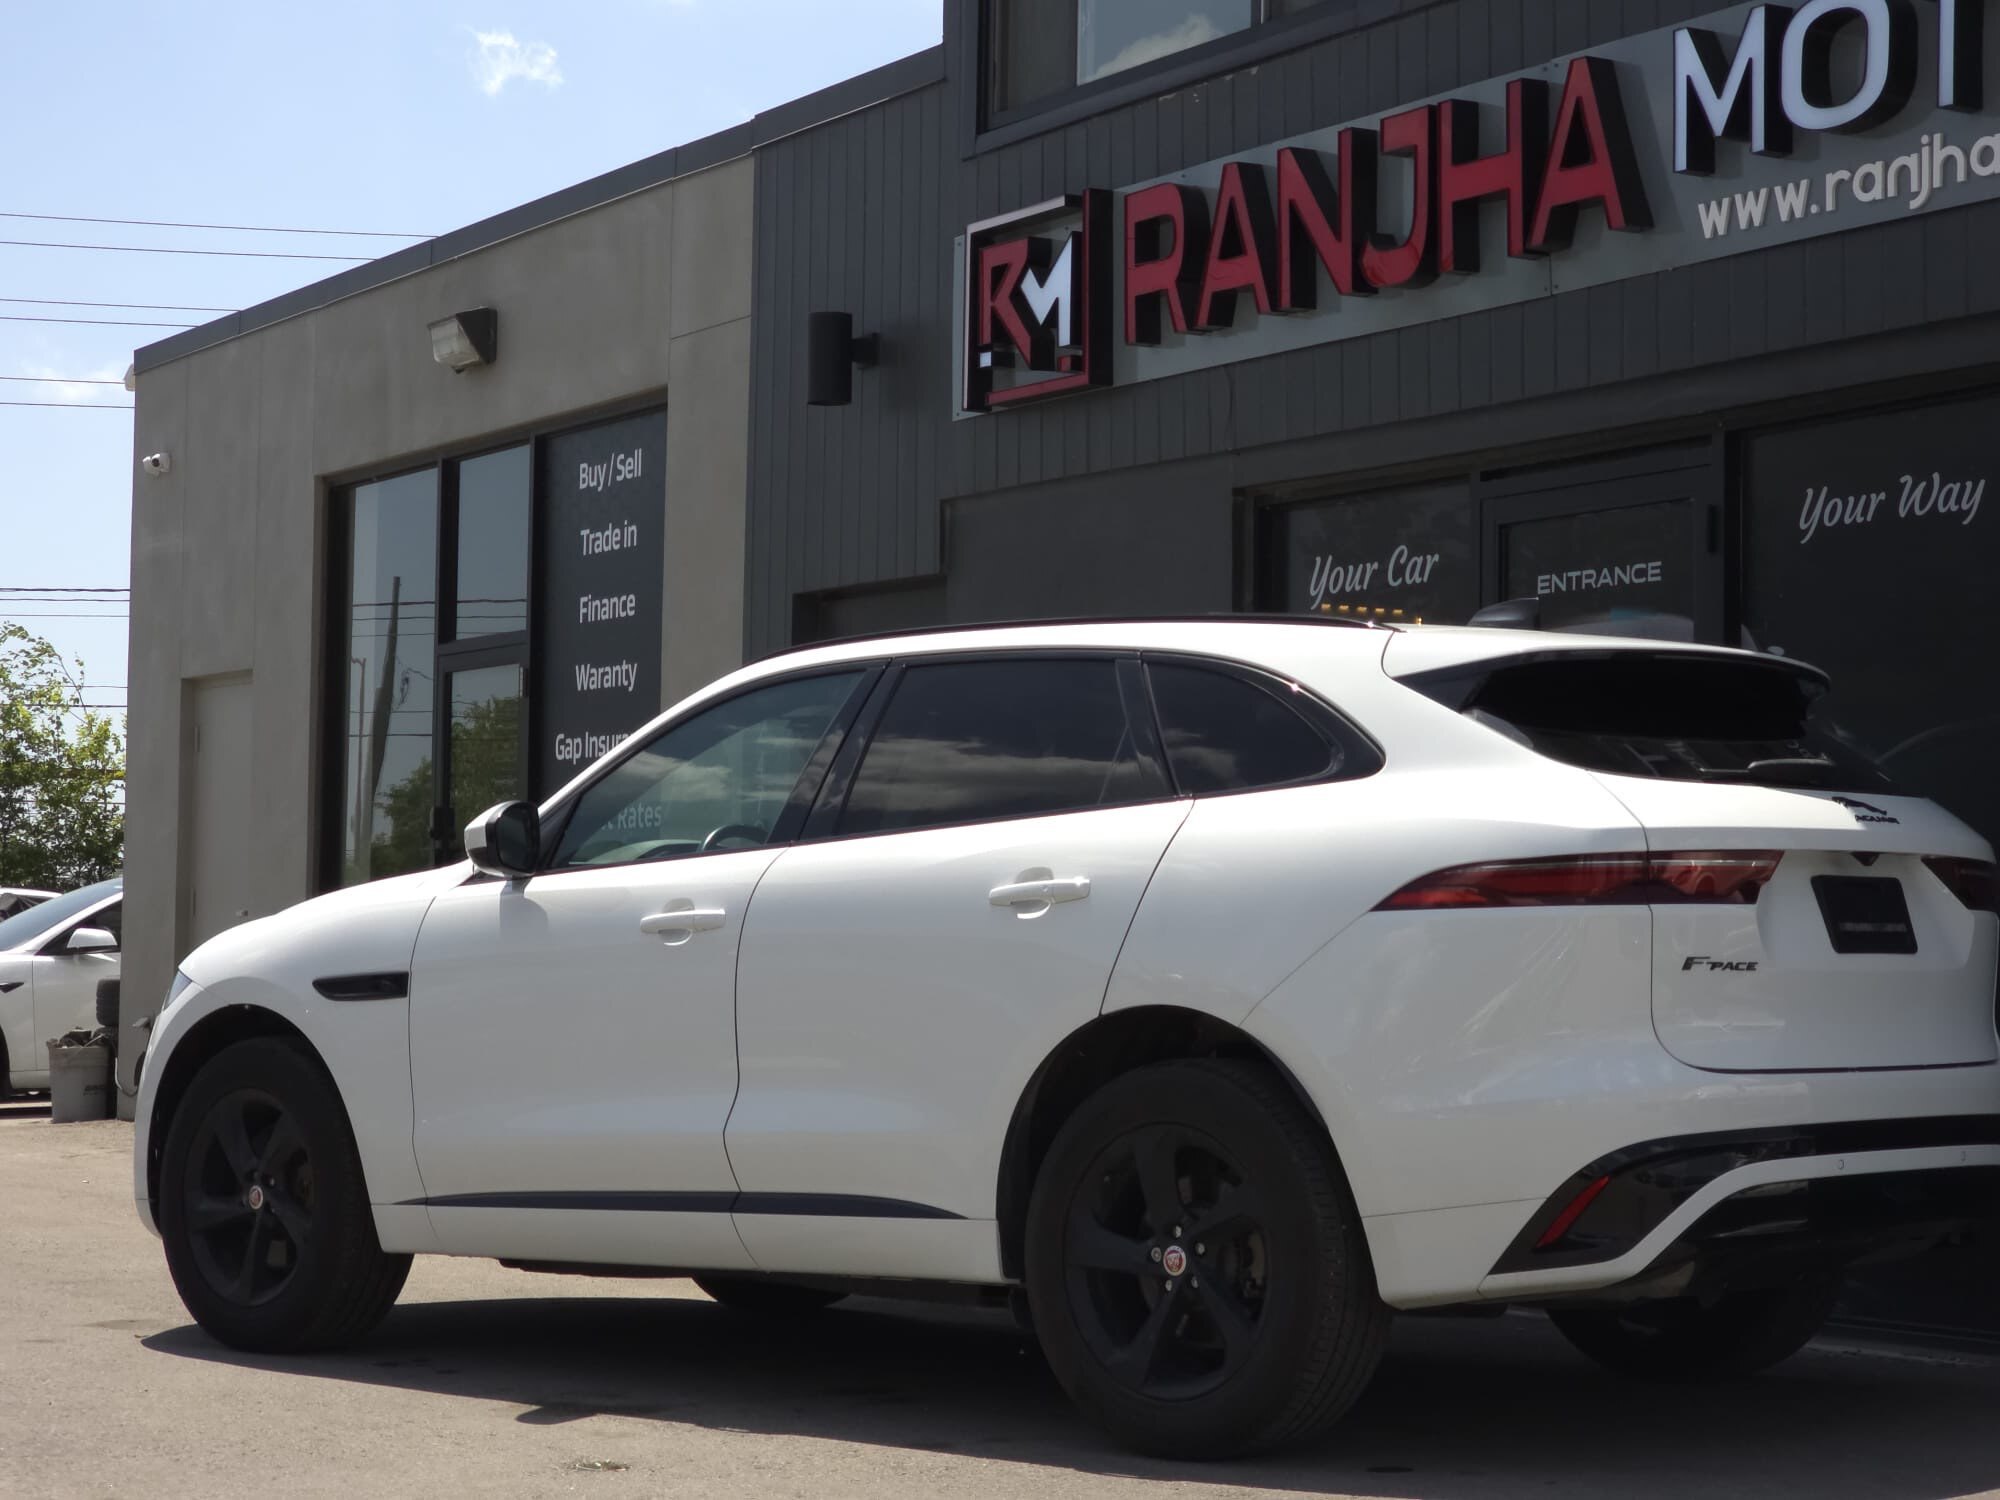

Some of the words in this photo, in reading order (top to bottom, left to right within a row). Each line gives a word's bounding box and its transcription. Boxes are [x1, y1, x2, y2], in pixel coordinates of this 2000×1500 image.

[1124, 56, 1640, 346] RANJHA
[579, 462, 607, 492] Buy
[616, 447, 642, 482] Sell
[1799, 485, 1886, 544] Your
[1898, 471, 1986, 525] Way
[580, 522, 621, 556] Trade
[623, 519, 637, 548] in
[1309, 555, 1378, 610] Your
[1387, 544, 1439, 588] Car
[1537, 561, 1662, 595] ENTRANCE
[579, 593, 636, 624] Finance
[575, 659, 638, 692] Waranty
[555, 733, 582, 766] Gap
